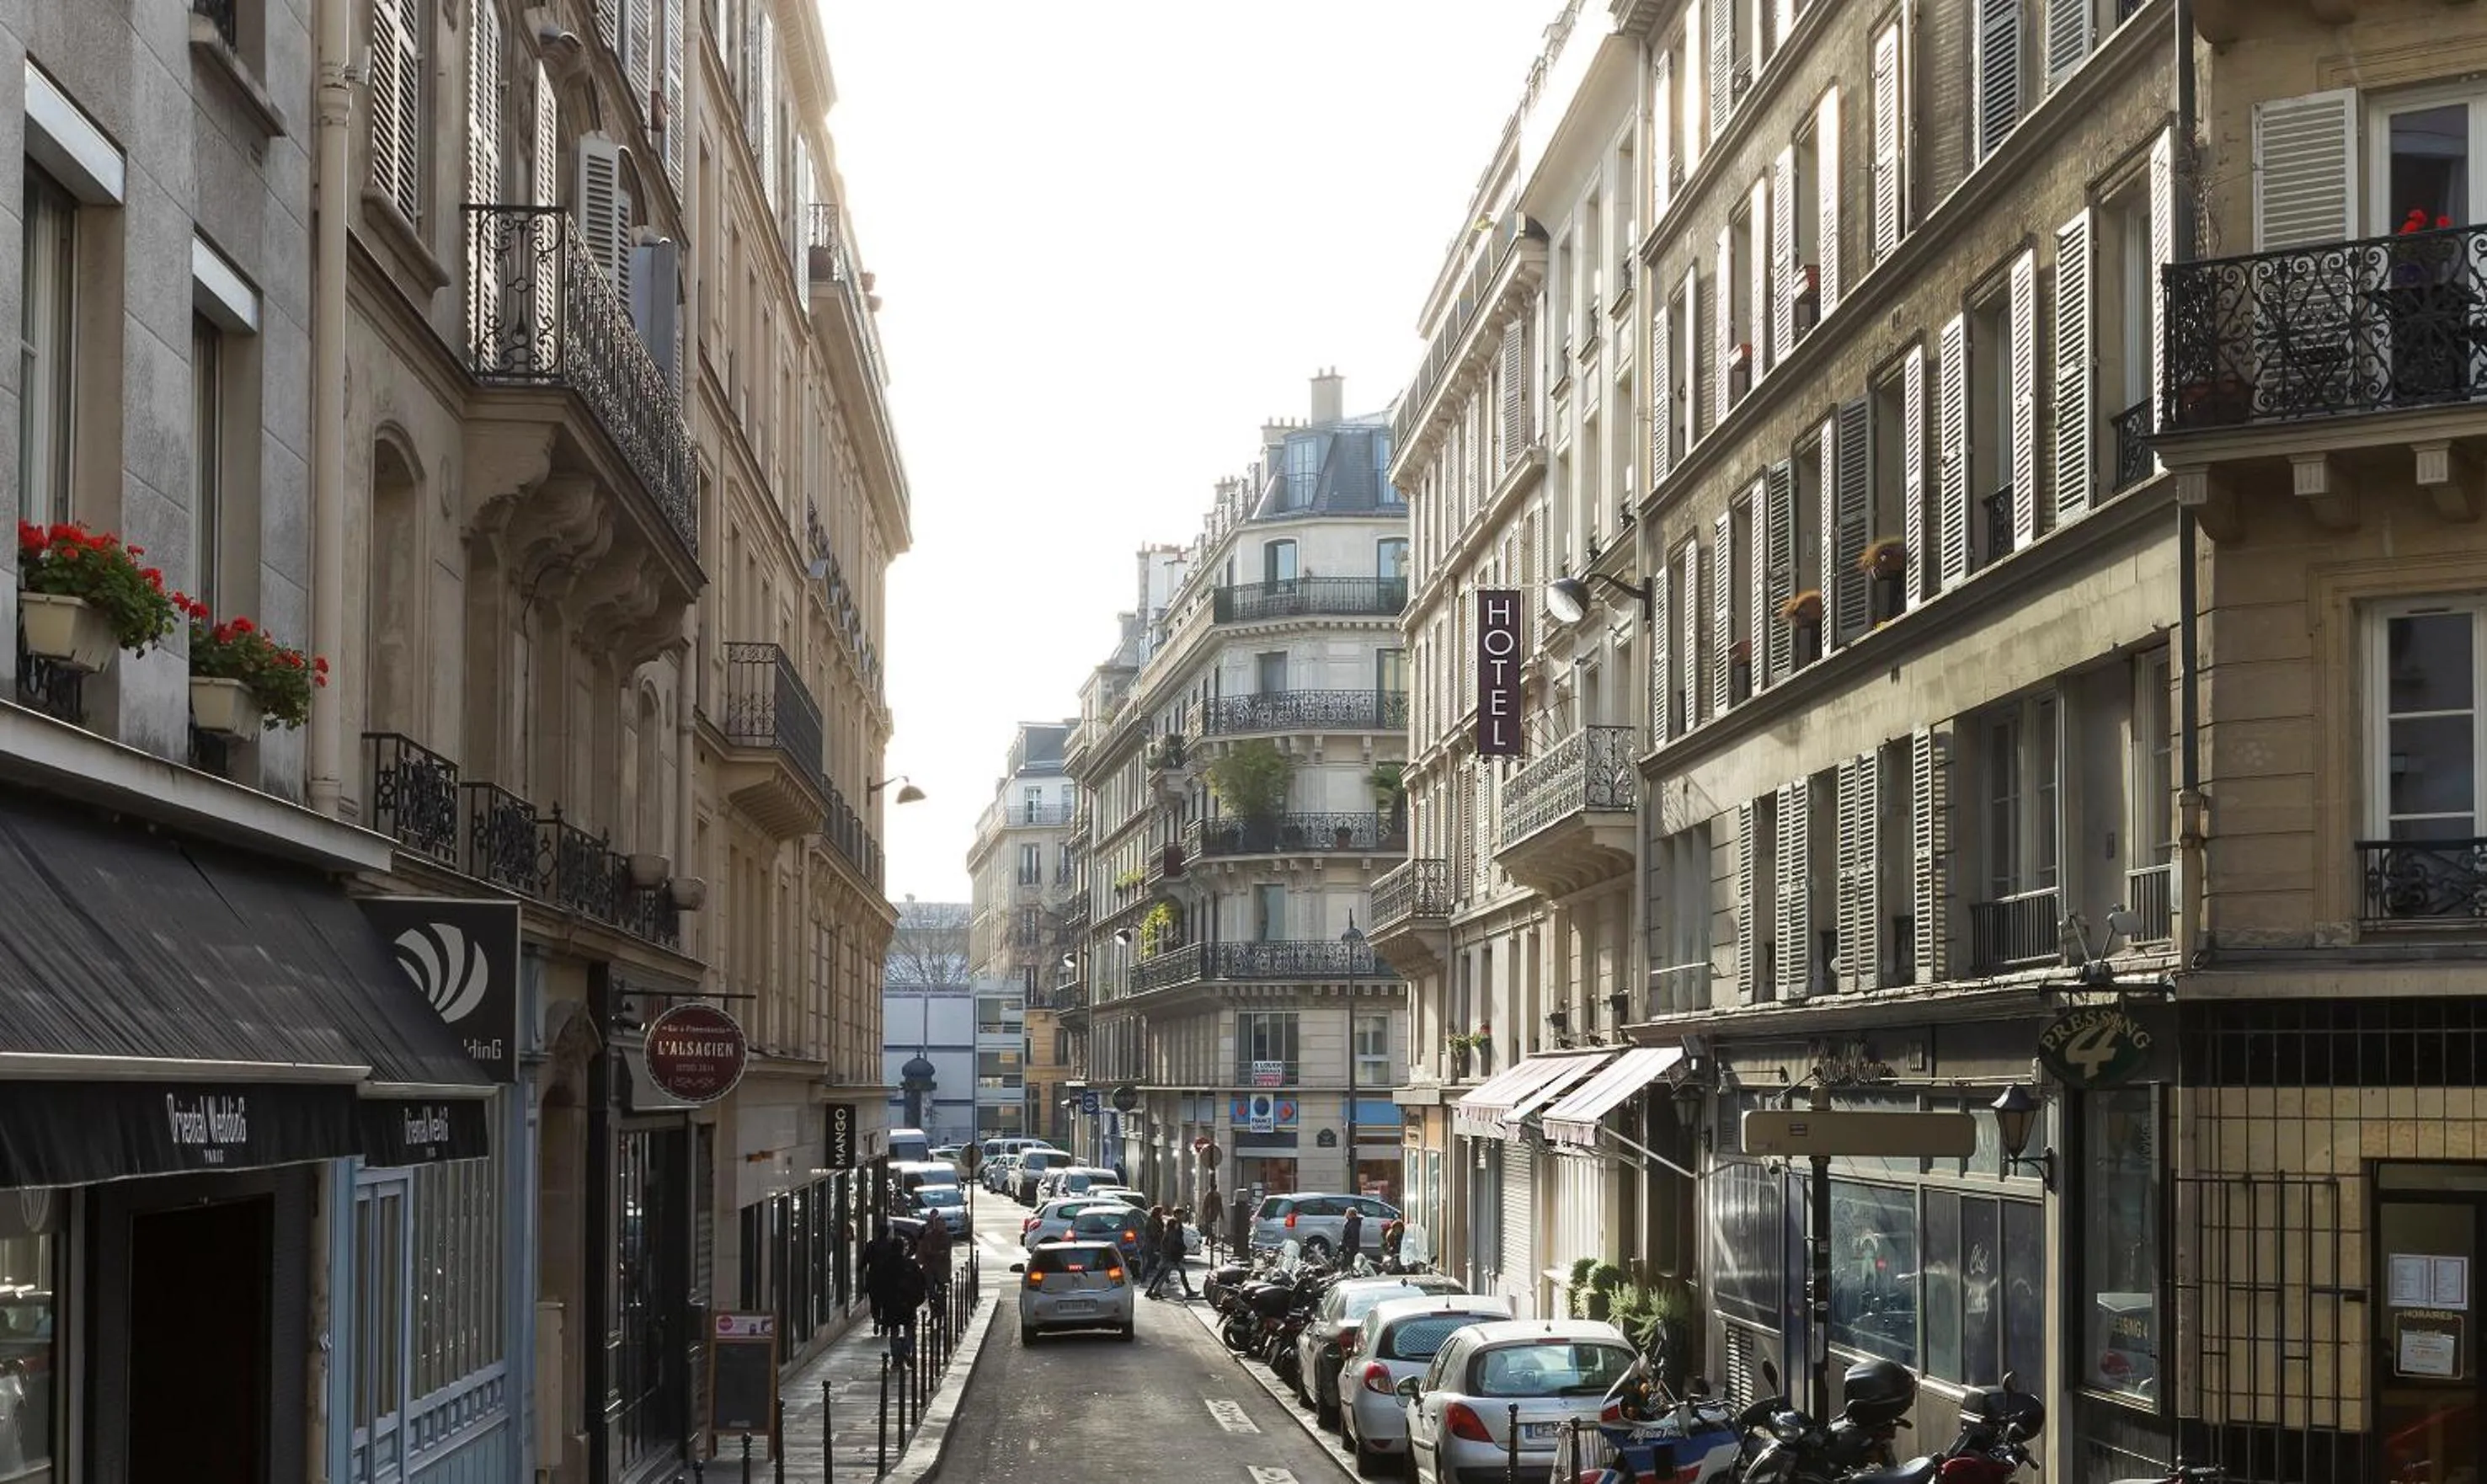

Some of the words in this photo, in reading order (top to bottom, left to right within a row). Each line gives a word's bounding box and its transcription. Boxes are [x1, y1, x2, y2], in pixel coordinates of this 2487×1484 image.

[1485, 599, 1514, 746] HOTEL
[657, 1039, 734, 1058] L'ALSACIEN
[2041, 1010, 2152, 1052] PRESSING
[2065, 1013, 2121, 1079] 4
[167, 1092, 208, 1145] Oriental
[835, 1108, 846, 1166] MANGO
